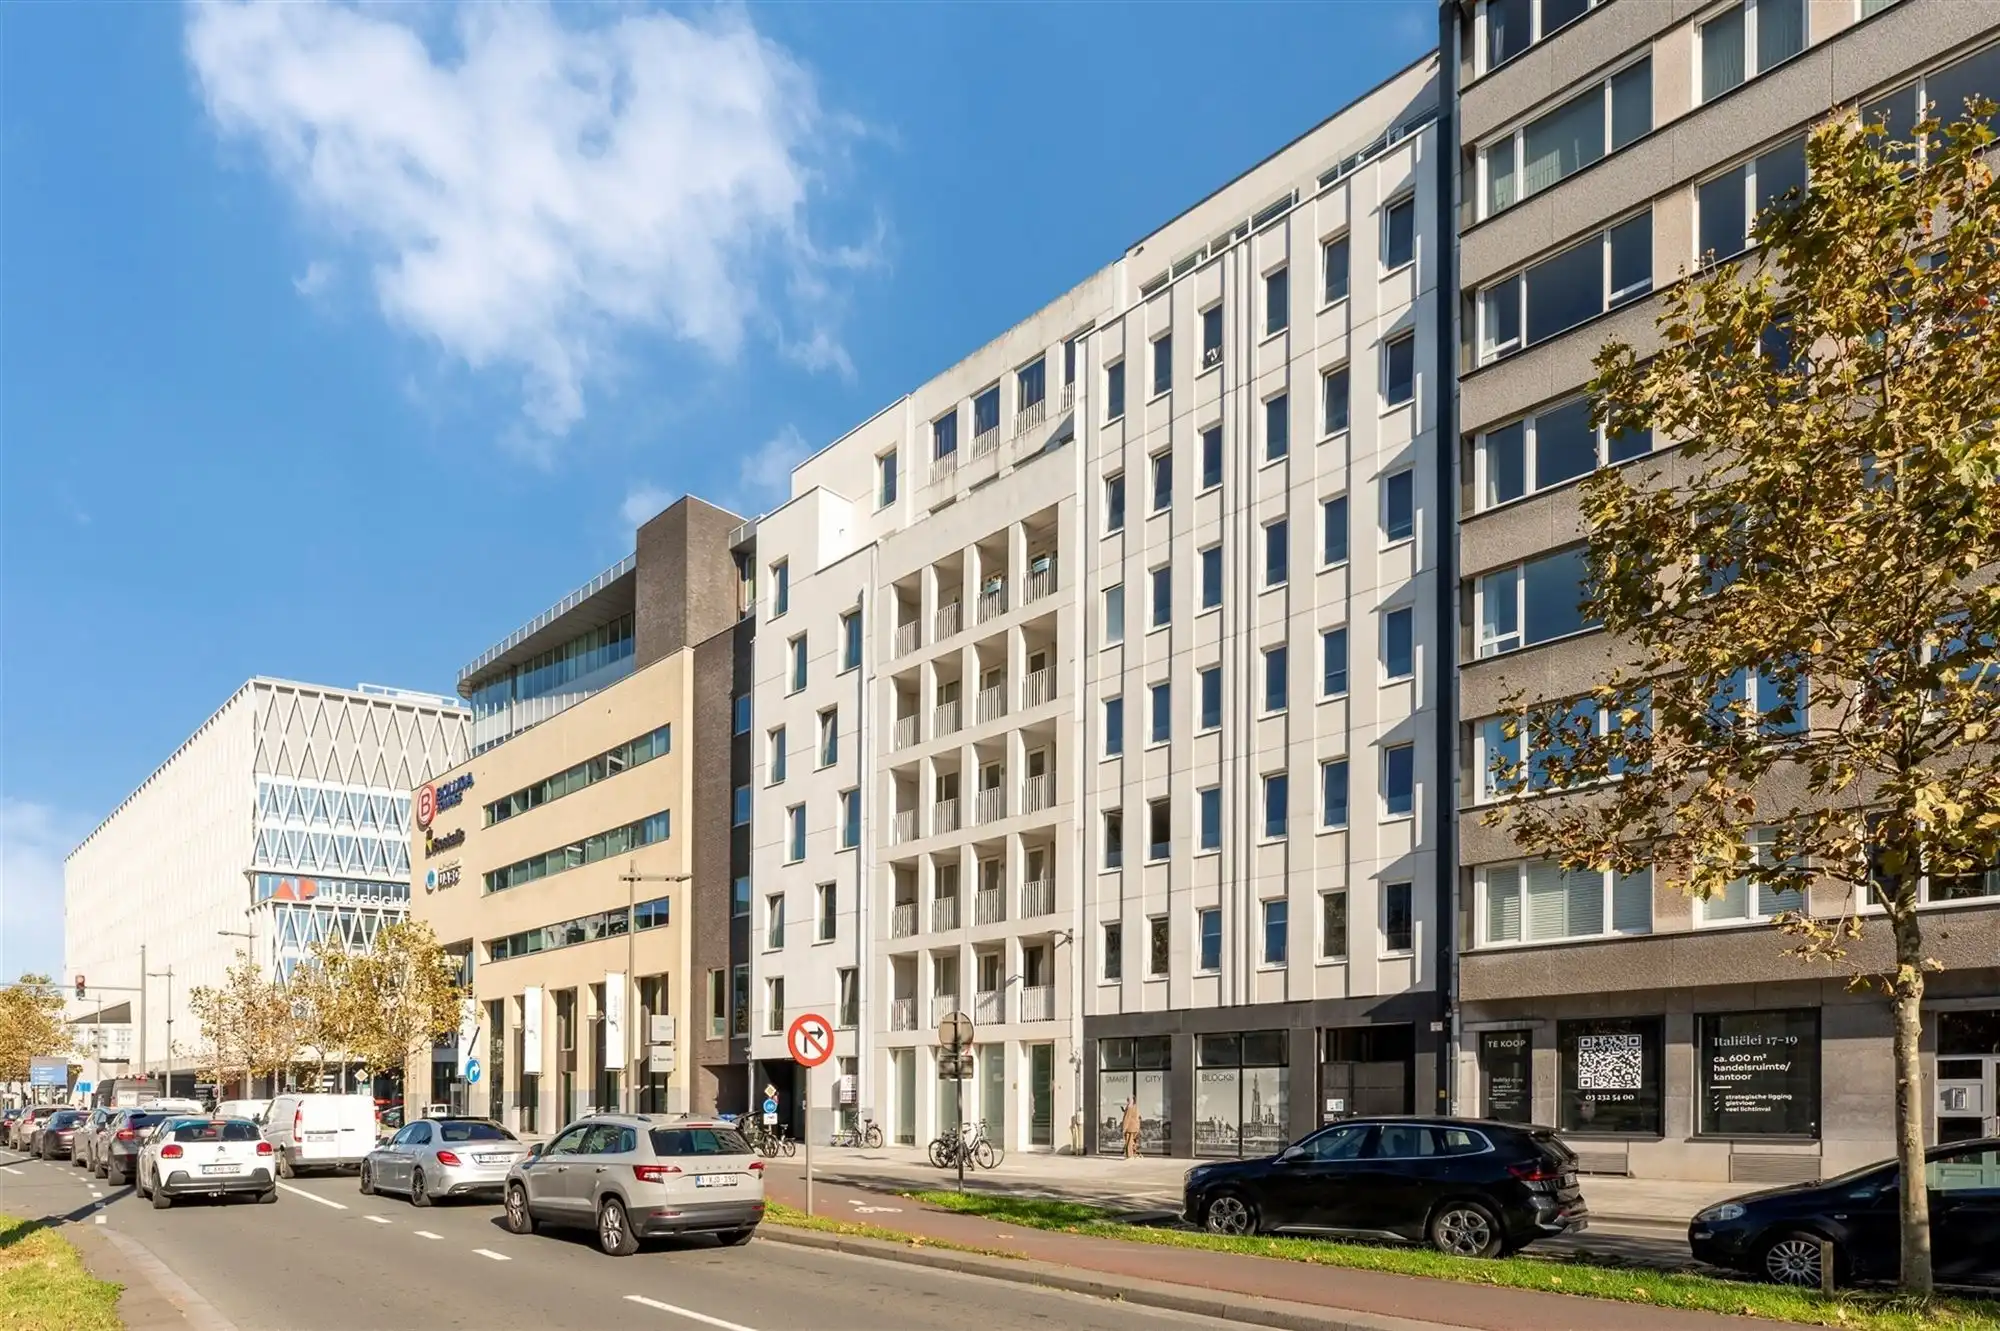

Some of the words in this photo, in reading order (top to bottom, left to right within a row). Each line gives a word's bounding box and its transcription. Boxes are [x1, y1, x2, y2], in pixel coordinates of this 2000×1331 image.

[1488, 1040, 1498, 1048] TE
[1500, 1039, 1526, 1048] KOOP
[1766, 1036, 1798, 1046] 17-19
[1729, 1054, 1751, 1062] 600
[1753, 1053, 1767, 1062] m²
[1713, 1061, 1791, 1072] handelsruimte/
[1105, 1075, 1129, 1084] SMART
[1145, 1074, 1162, 1083] CITY
[1201, 1073, 1234, 1082] BLOCKS
[1713, 1073, 1752, 1081] kantoor
[1585, 1094, 1596, 1102] 03
